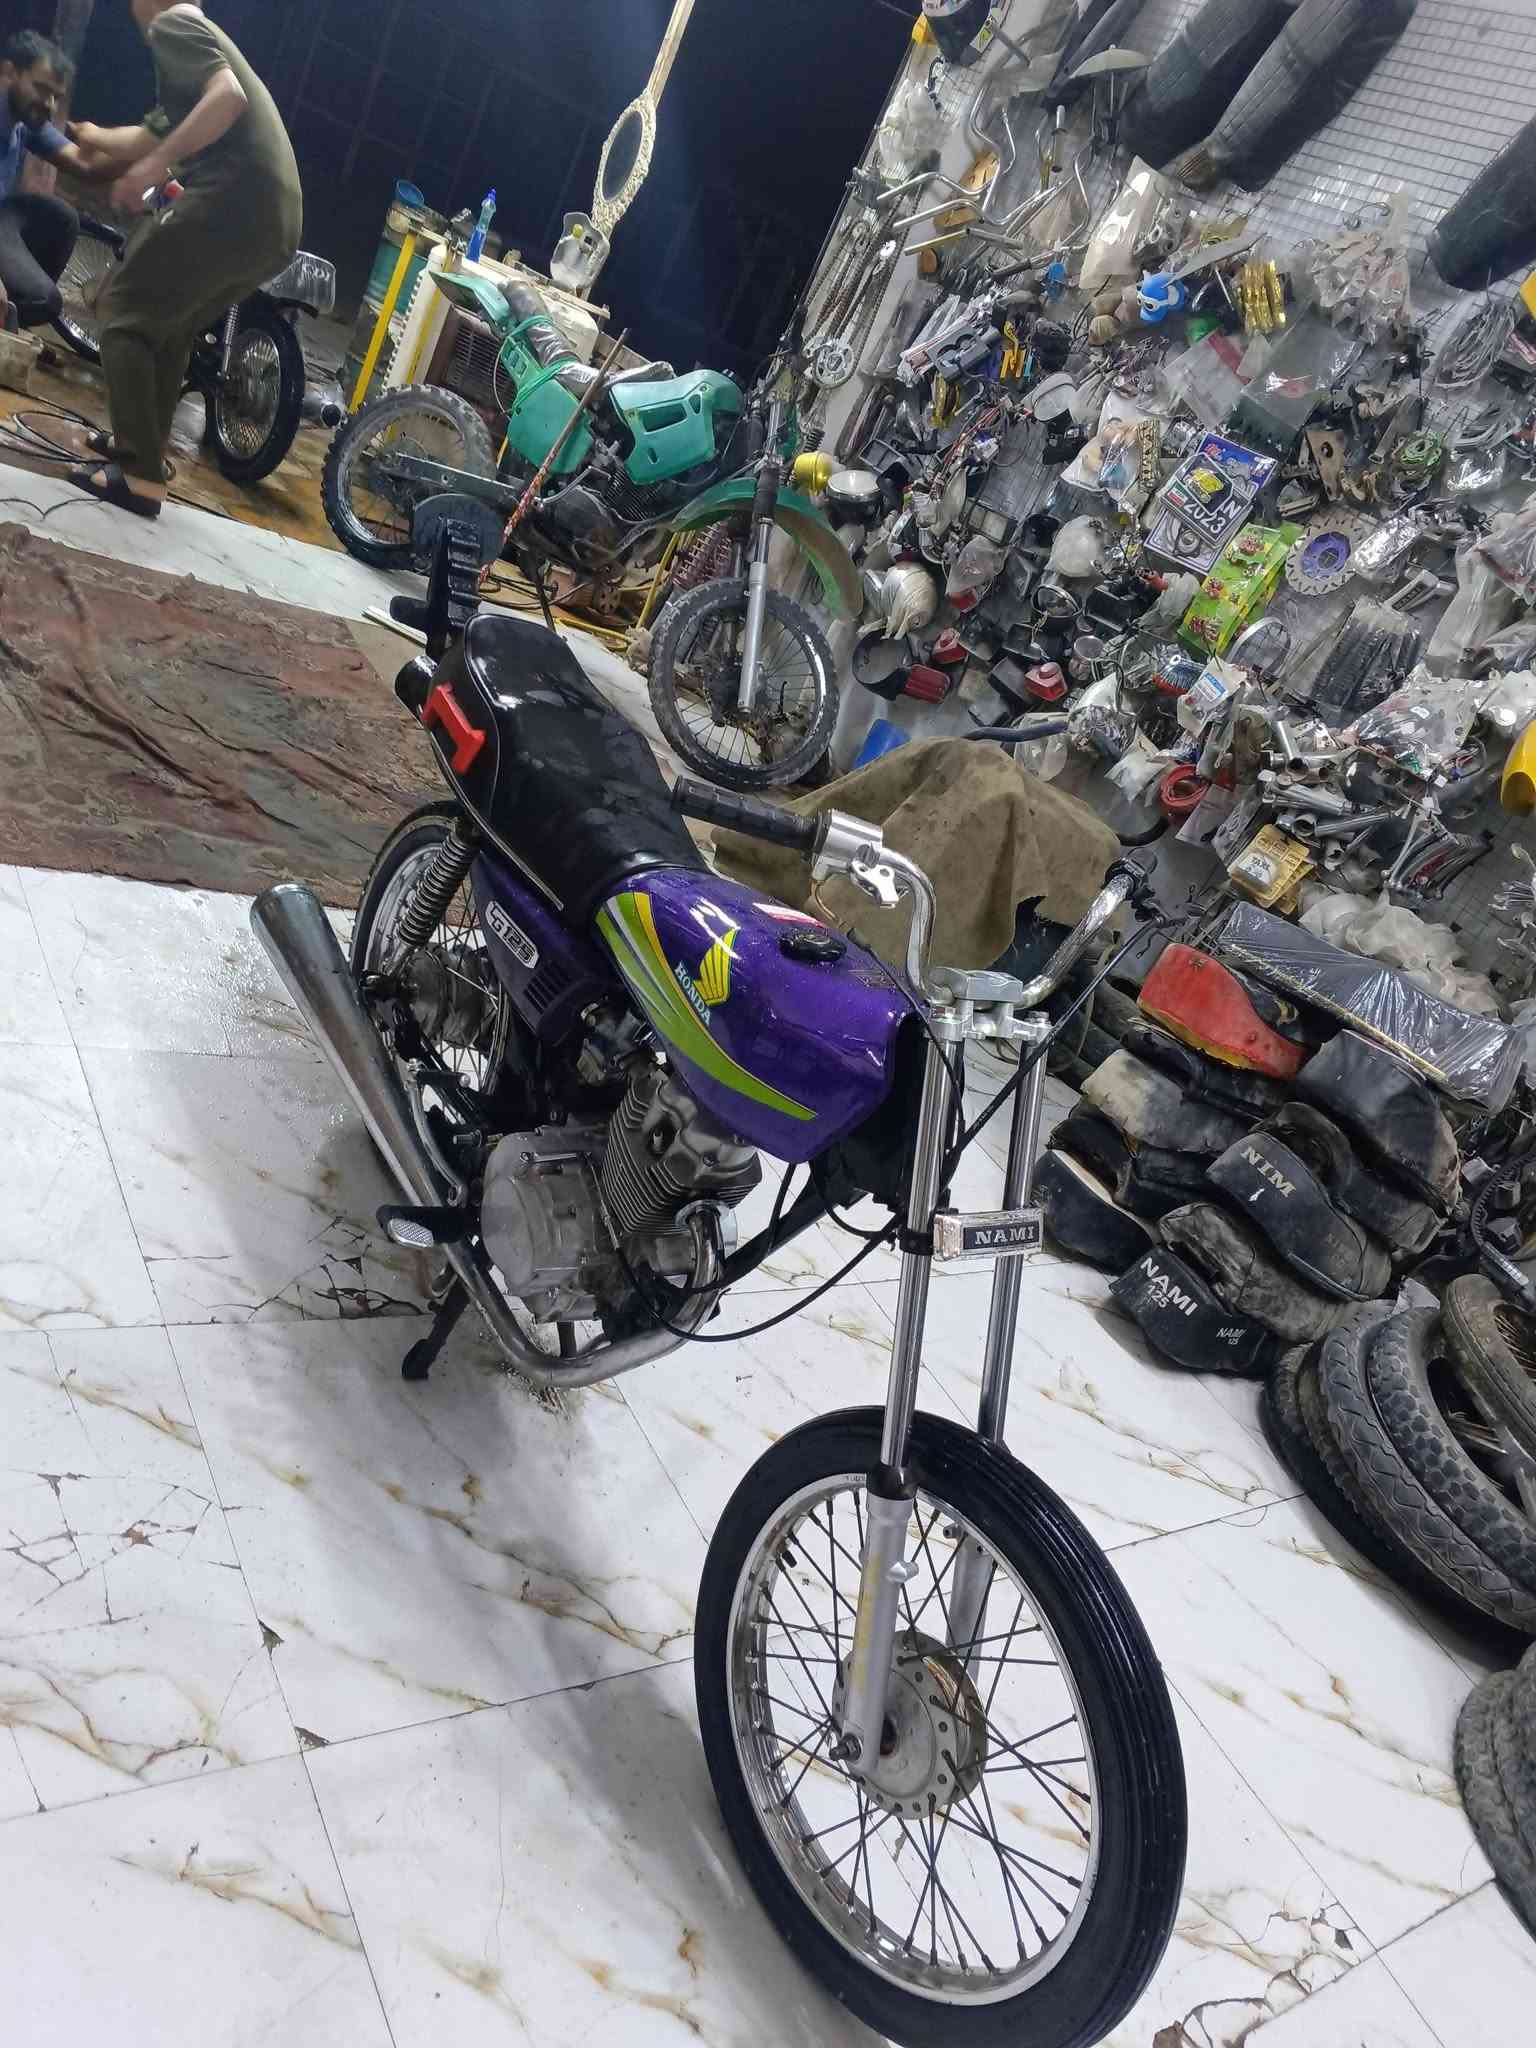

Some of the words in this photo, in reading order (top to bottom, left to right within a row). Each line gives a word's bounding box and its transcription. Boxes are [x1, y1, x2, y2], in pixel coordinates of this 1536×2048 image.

[674, 960, 711, 1026] HONDA
[1240, 1146, 1297, 1198] NIM
[975, 1225, 1035, 1245] NAMI
[1140, 1257, 1198, 1317] NAMI
[1147, 1284, 1169, 1308] 125
